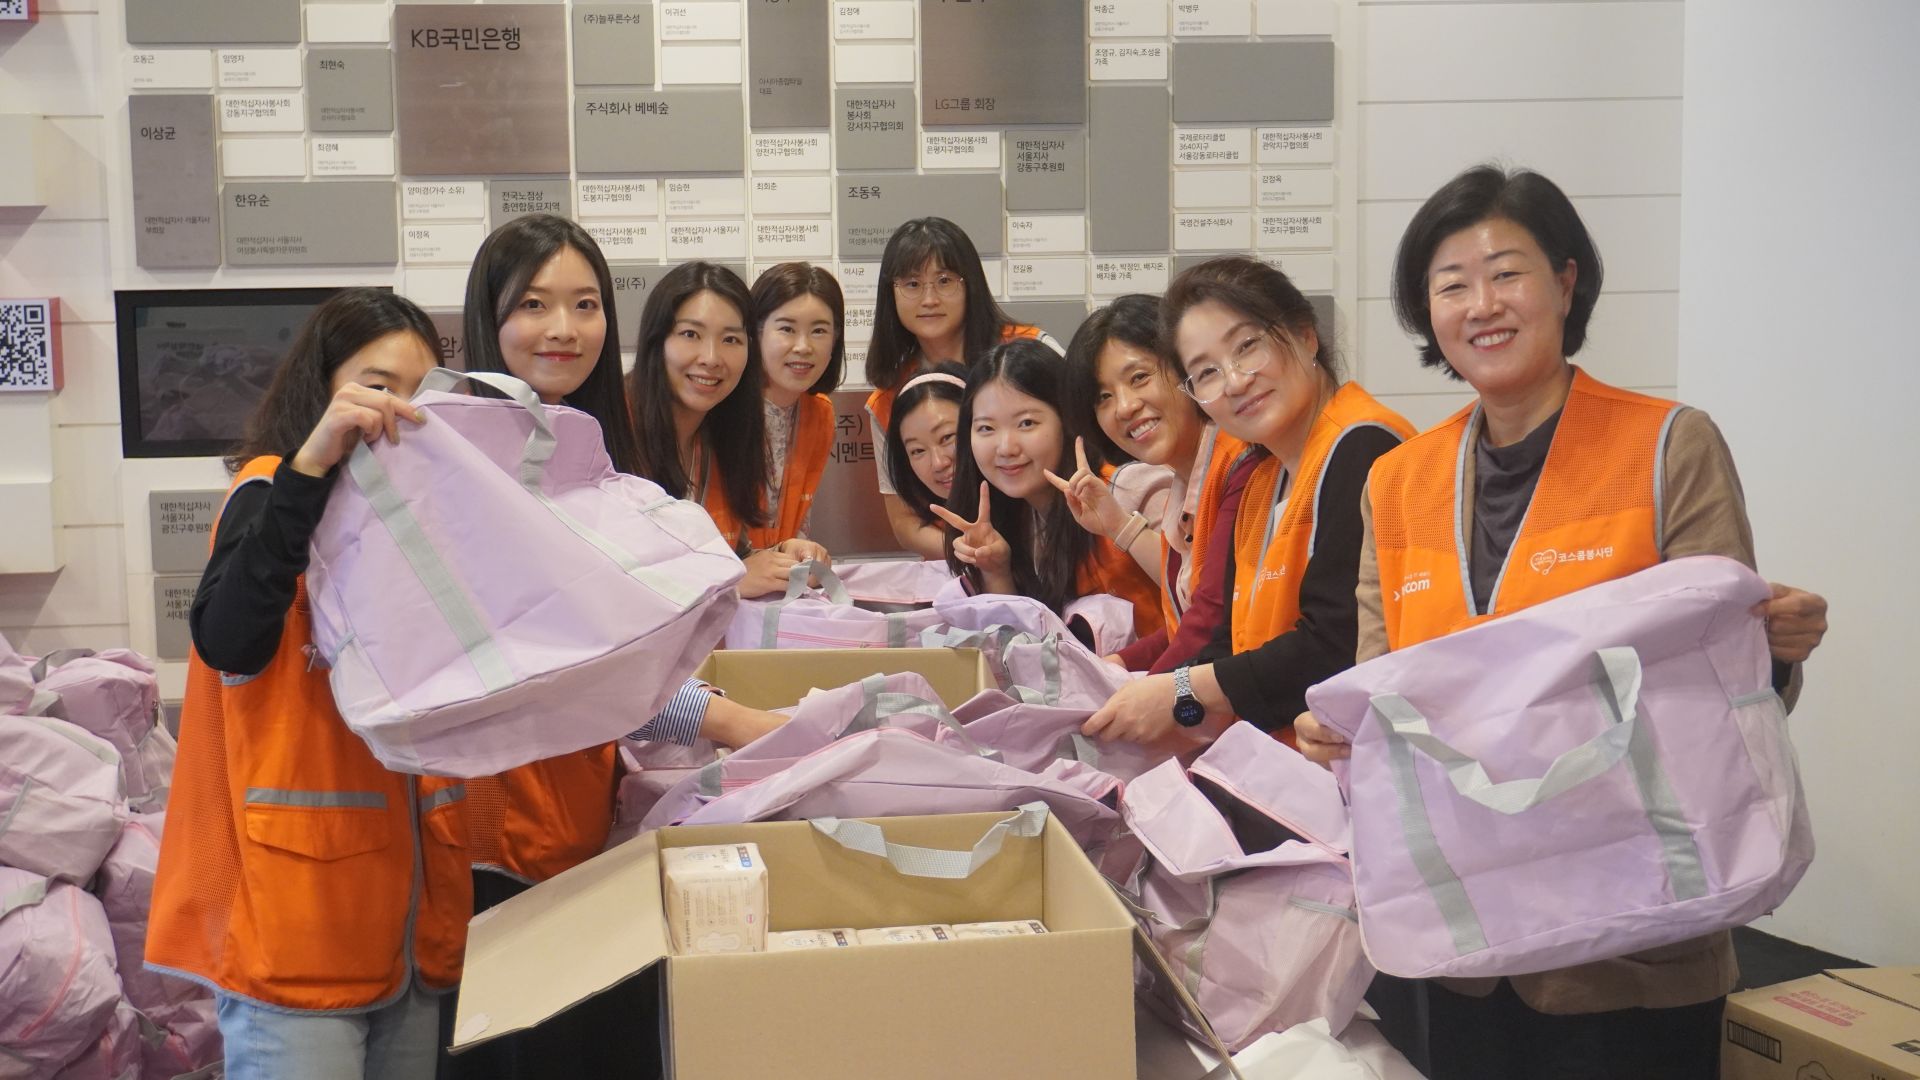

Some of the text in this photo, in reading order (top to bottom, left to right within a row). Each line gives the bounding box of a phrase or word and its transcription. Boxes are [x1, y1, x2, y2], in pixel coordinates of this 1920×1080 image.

[411, 27, 520, 51] KB국민은행
[320, 60, 345, 71] 최현숙
[1094, 58, 1109, 66] 가족
[225, 100, 291, 108] 대한적십자사봉사회
[585, 101, 670, 116] 주식회사 베베숲
[847, 99, 896, 109] 대한적십자사
[935, 98, 995, 111] LG그룹 회장
[226, 109, 277, 118] 강동지구협의회
[847, 111, 872, 121] 봉사회
[847, 122, 904, 132] 강서지구협의회
[140, 127, 176, 141] 이상균
[1179, 133, 1226, 142] 국제로타리클럽
[1262, 132, 1322, 140] 대한적십자사봉사회
[755, 138, 818, 147] 대한적십자사봉사회
[927, 136, 988, 144] 대한적십자사봉사회
[927, 146, 975, 154] 은평지구협의회
[1016, 140, 1065, 151] 대한적십자사
[1262, 141, 1309, 150] 관악지구협의회
[756, 148, 804, 156] 양천지구협의회
[1016, 151, 1049, 161] 서울지사
[1179, 151, 1239, 160] 서울강동로타리클럽
[1016, 162, 1065, 172] 강동구후원회
[582, 184, 646, 193] 대한적십자사봉사회
[848, 186, 881, 199] 조동옥
[235, 194, 270, 207] 한유순
[502, 191, 543, 201] 전국노점상
[583, 194, 632, 202] 도봉지구협의회
[1262, 216, 1322, 225] 대한적십자사봉사회
[671, 226, 740, 235] 대한적십자사 서울지사
[757, 225, 819, 233] 대한적십자사봉사회
[1262, 226, 1309, 234] 구로지구협의회
[757, 234, 806, 243] 동작지구협의회
[1119, 272, 1132, 280] 가족
[160, 502, 211, 511] 대한적십자사
[161, 513, 195, 523] 서울지사
[1558, 546, 1614, 563] 코스콤봉사단
